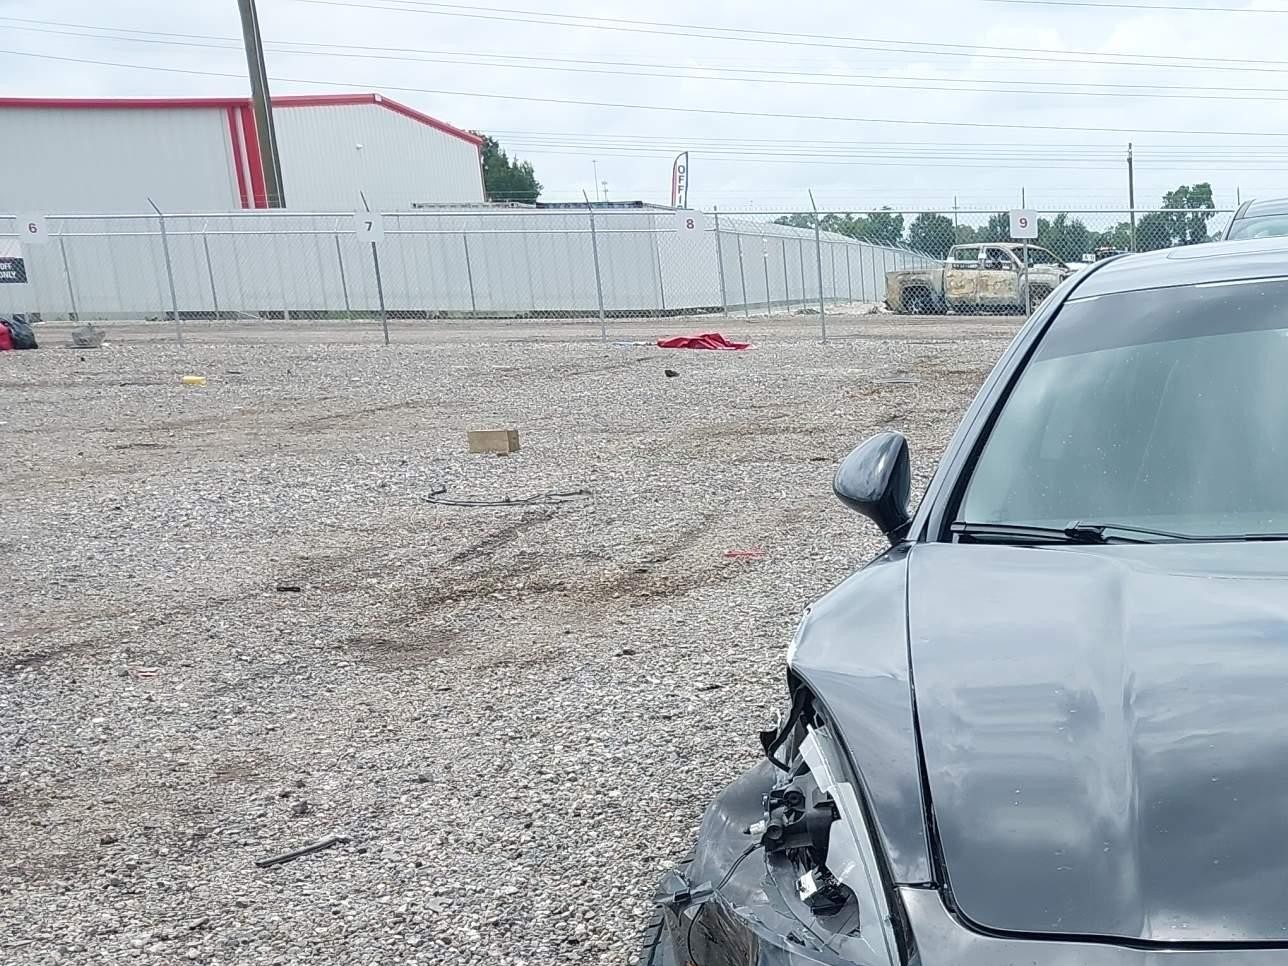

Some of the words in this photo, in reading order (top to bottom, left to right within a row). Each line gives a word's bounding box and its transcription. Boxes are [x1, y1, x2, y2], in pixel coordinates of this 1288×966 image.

[28, 222, 38, 233] 6
[364, 221, 373, 231] 7
[686, 218, 695, 230] 8
[1019, 217, 1028, 228] 9
